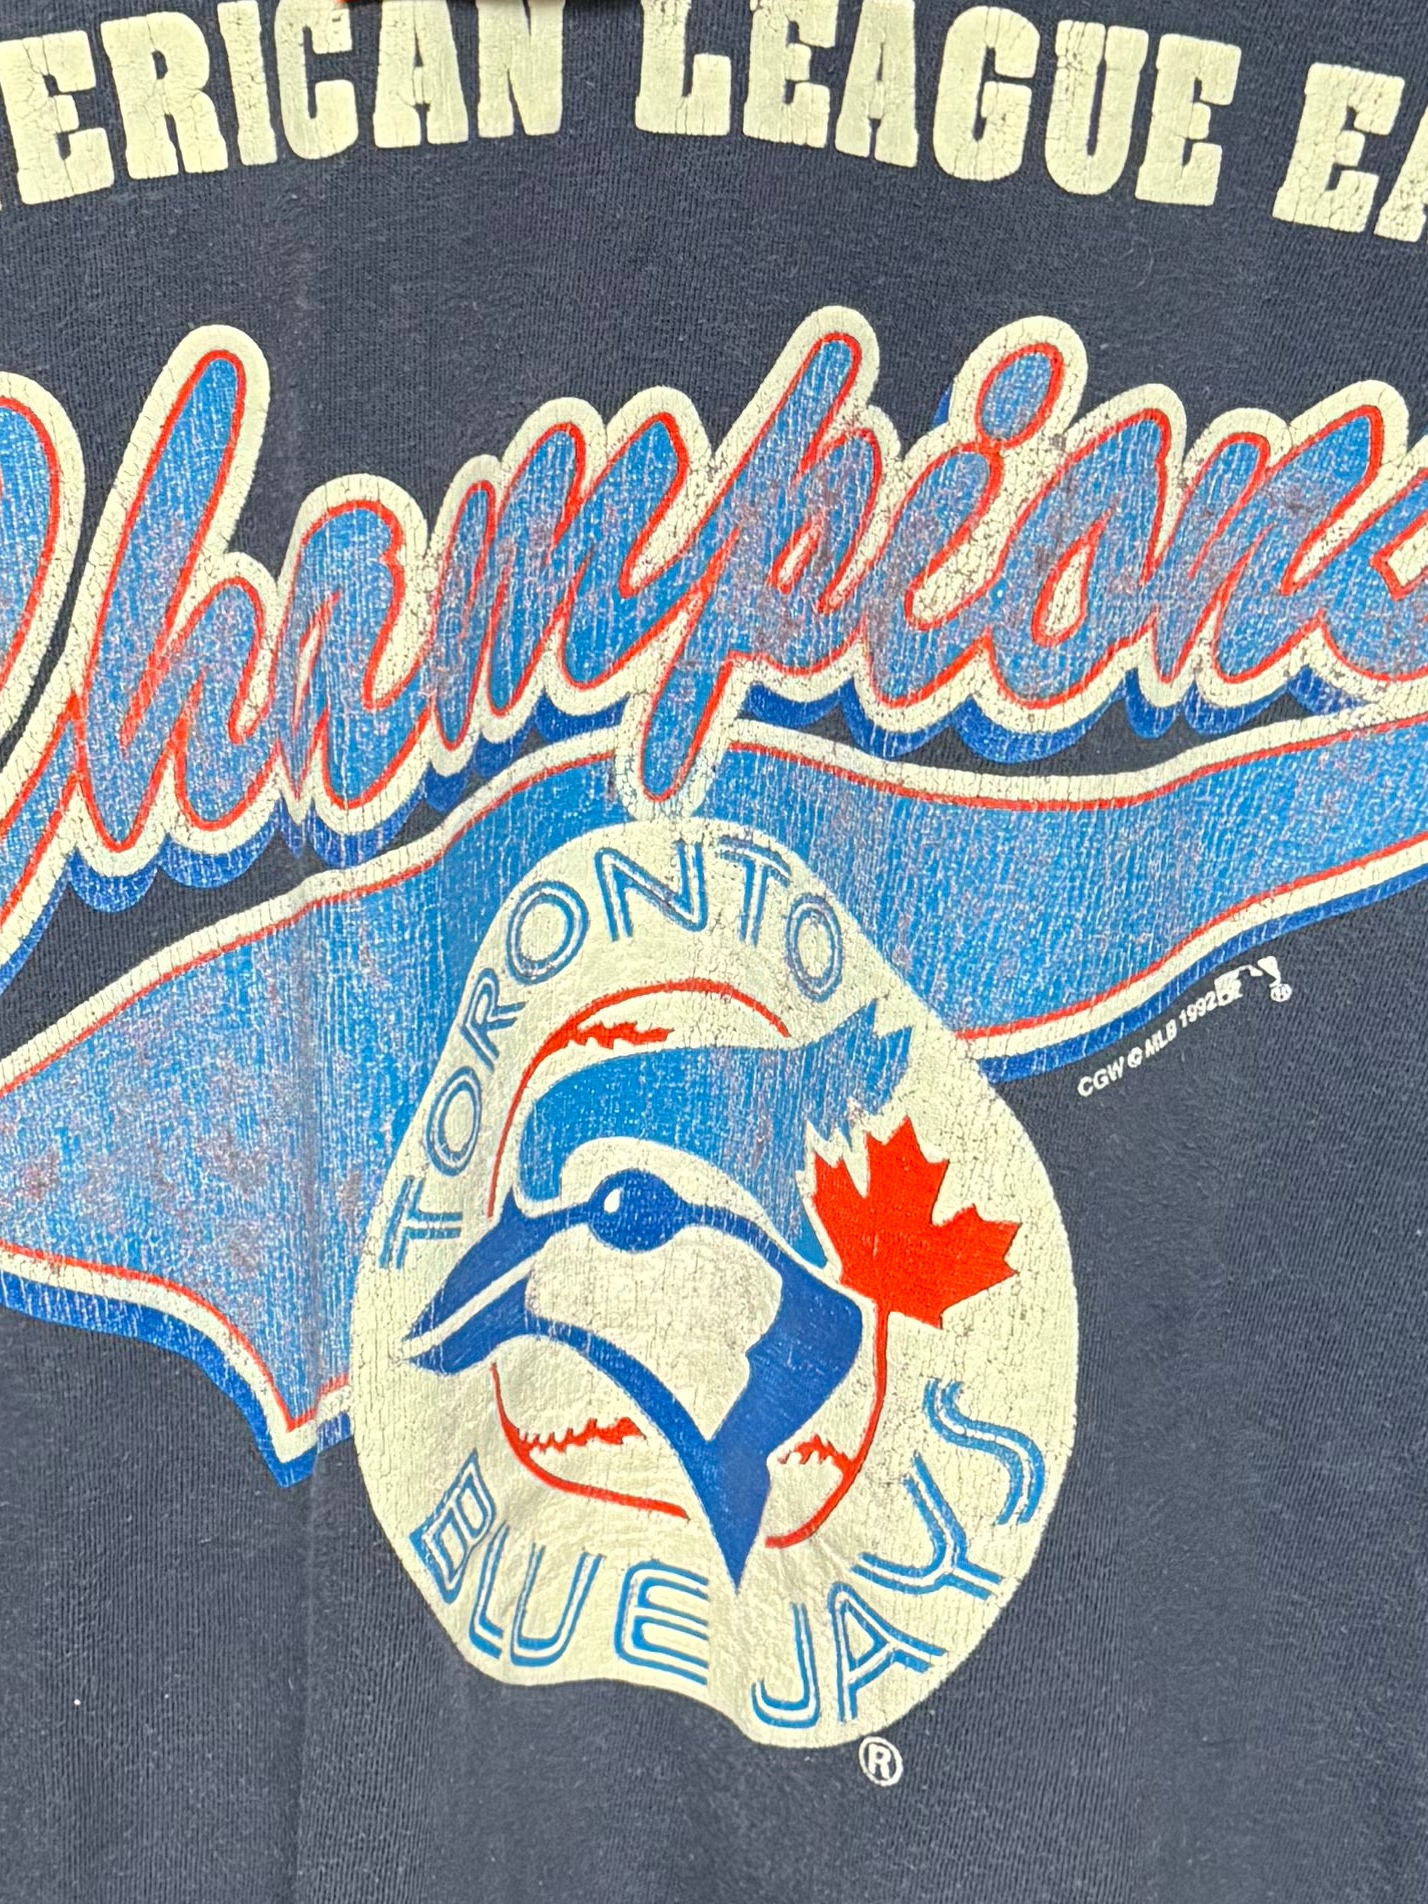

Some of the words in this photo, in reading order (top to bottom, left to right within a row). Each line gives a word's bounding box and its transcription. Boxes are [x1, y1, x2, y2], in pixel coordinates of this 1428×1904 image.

[378, 836, 846, 1270] TORONTO
[1077, 1056, 1126, 1098] CGW
[1143, 1019, 1178, 1058] MLB
[1178, 989, 1217, 1028] 1992
[409, 1449, 710, 1687] BLUE
[750, 1380, 1047, 1728] JAYS
